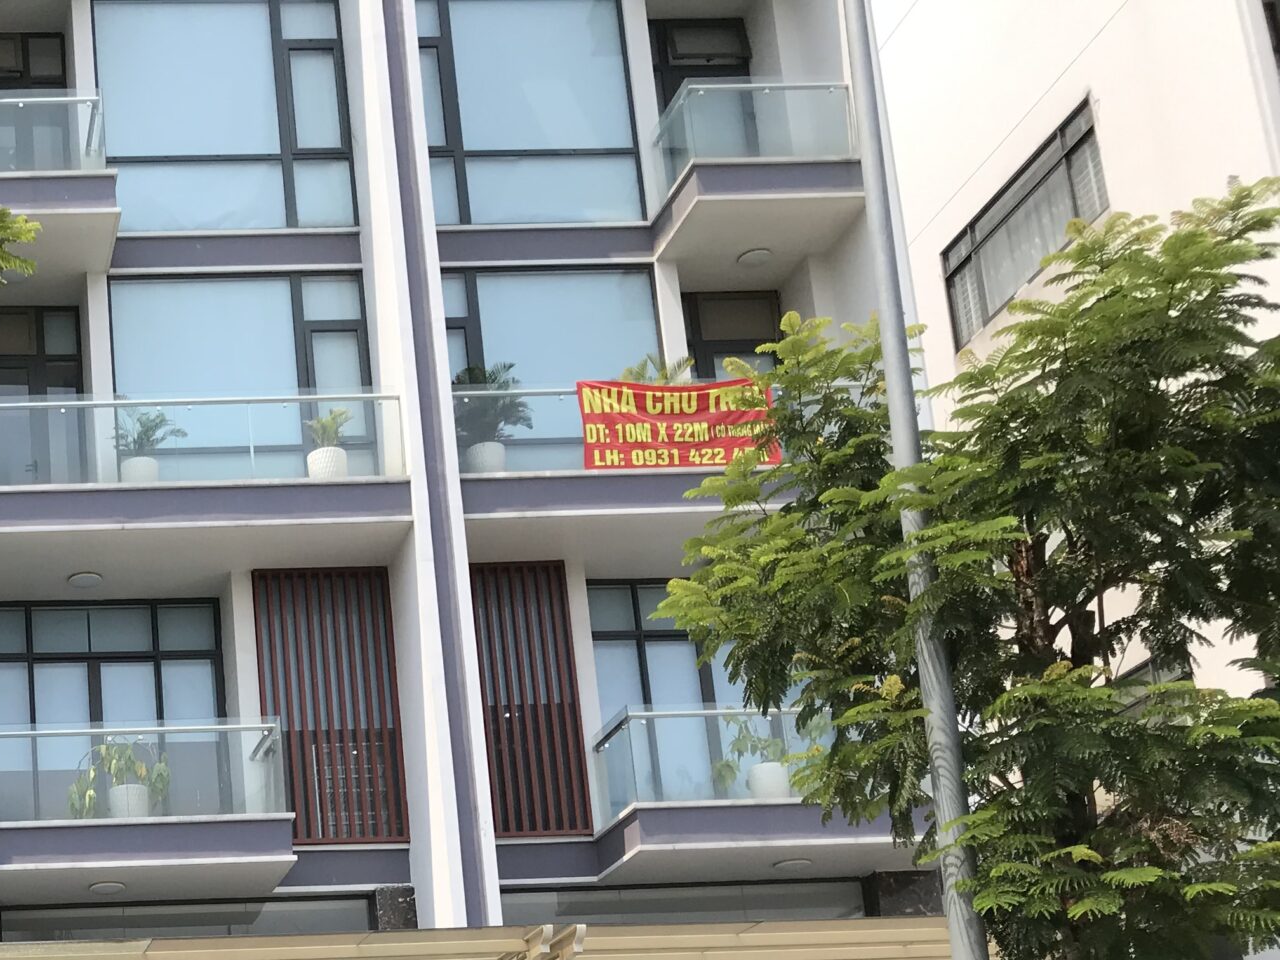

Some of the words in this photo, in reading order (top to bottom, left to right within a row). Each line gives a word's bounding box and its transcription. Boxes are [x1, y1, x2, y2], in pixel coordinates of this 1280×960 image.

[585, 423, 611, 443] DT:
[616, 422, 652, 443] 10M
[657, 422, 669, 442] X
[674, 422, 709, 442] 22M
[593, 449, 625, 466] LH:
[631, 448, 680, 466] 0931
[689, 447, 727, 464] 422
